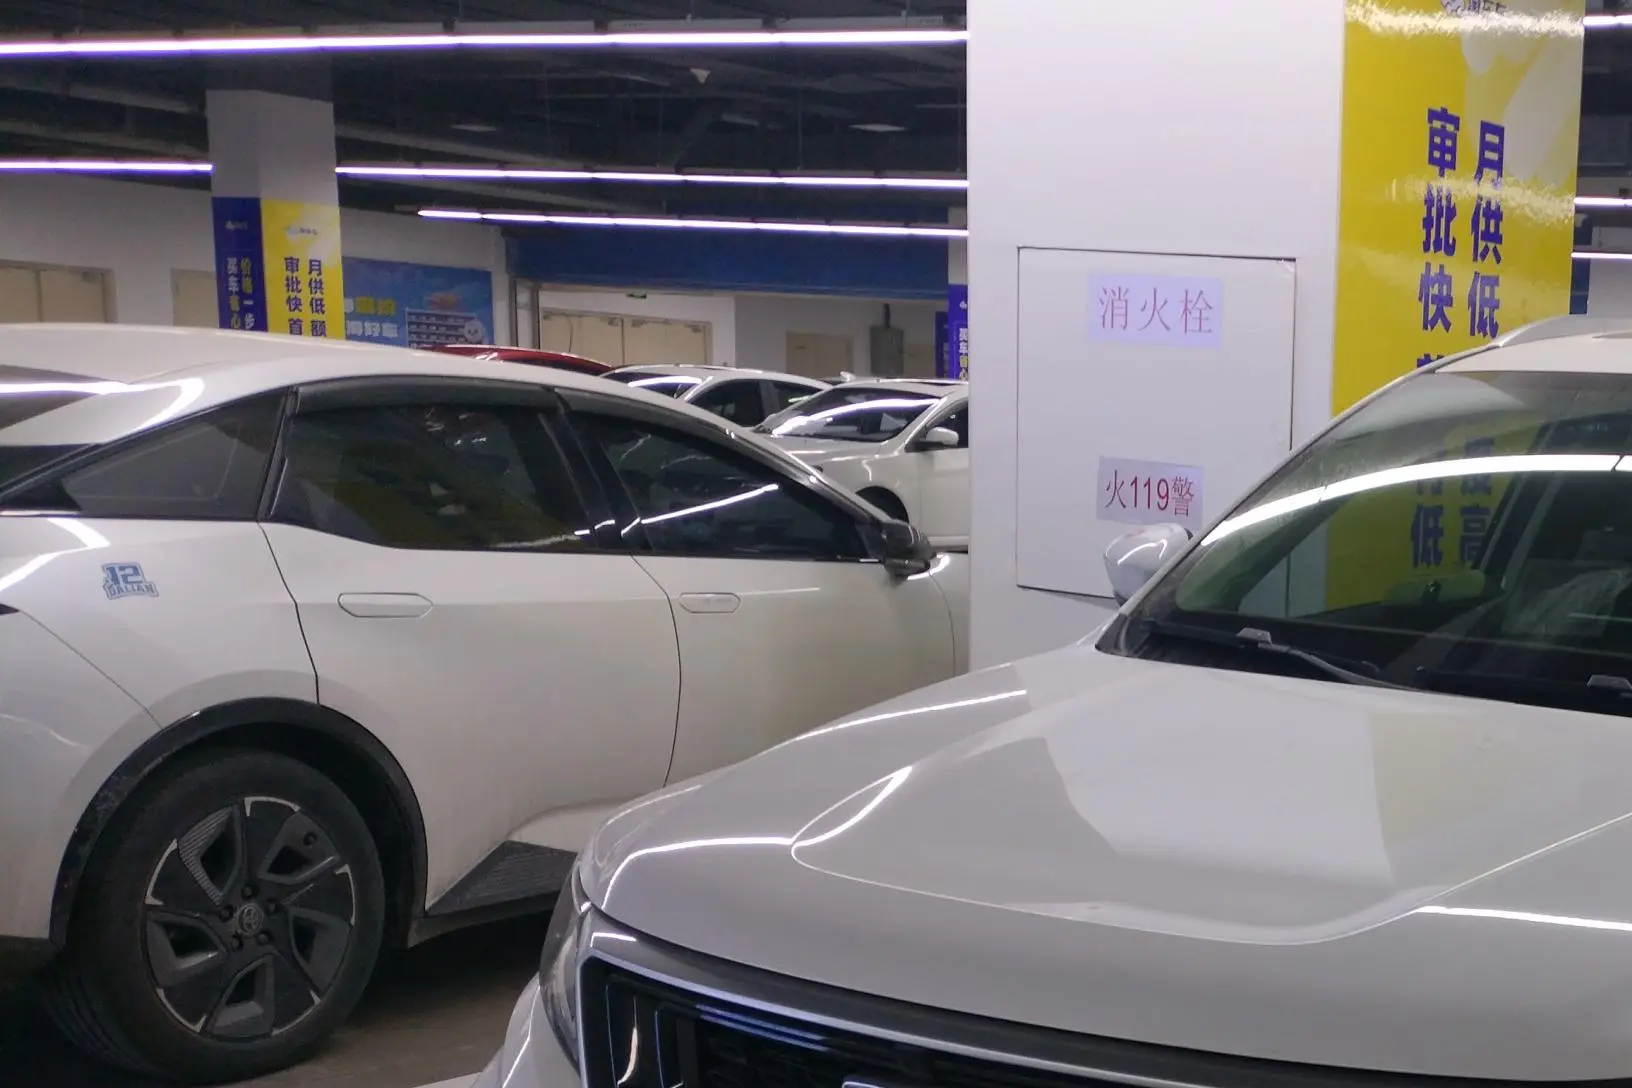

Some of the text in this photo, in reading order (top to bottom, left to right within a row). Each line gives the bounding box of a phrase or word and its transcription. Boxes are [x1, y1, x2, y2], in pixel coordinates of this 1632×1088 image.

[1418, 107, 1460, 333] 审批快
[1467, 120, 1505, 338] 月供低
[284, 256, 302, 313] 审批快
[308, 259, 325, 315] 月供低
[1099, 286, 1214, 334] 消火栓
[1105, 469, 1194, 517] 火119警
